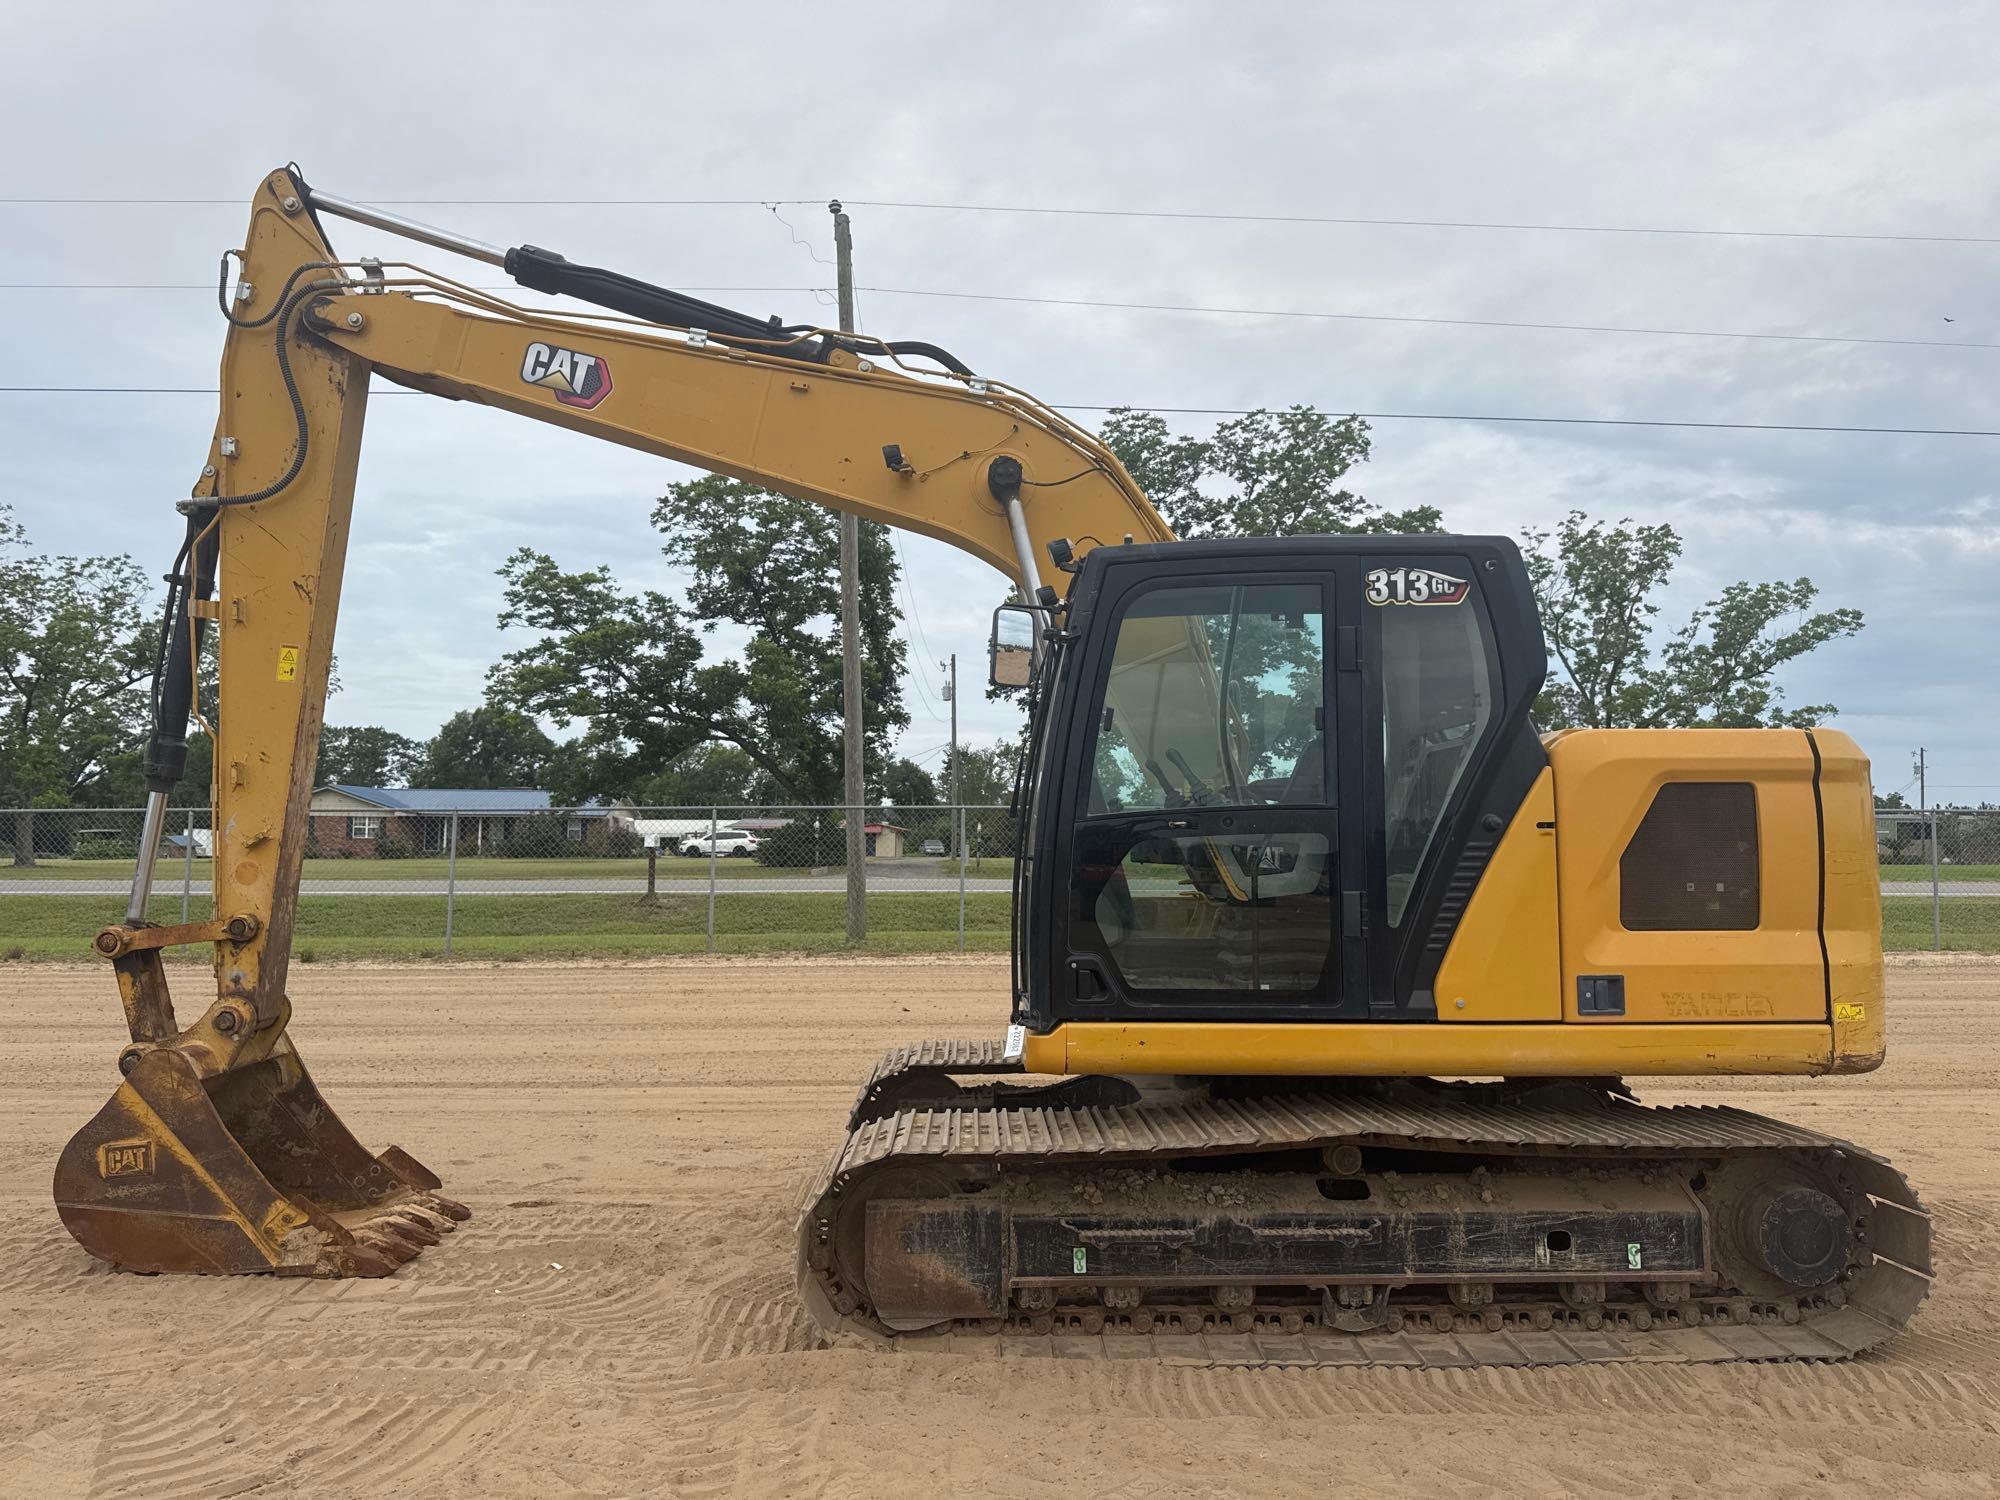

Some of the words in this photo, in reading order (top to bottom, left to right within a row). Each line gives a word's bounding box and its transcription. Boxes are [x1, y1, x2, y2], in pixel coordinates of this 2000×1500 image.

[522, 342, 596, 395] CAT
[1368, 569, 1429, 602] 313
[1431, 578, 1455, 593] GC
[108, 1148, 146, 1173] CAT
